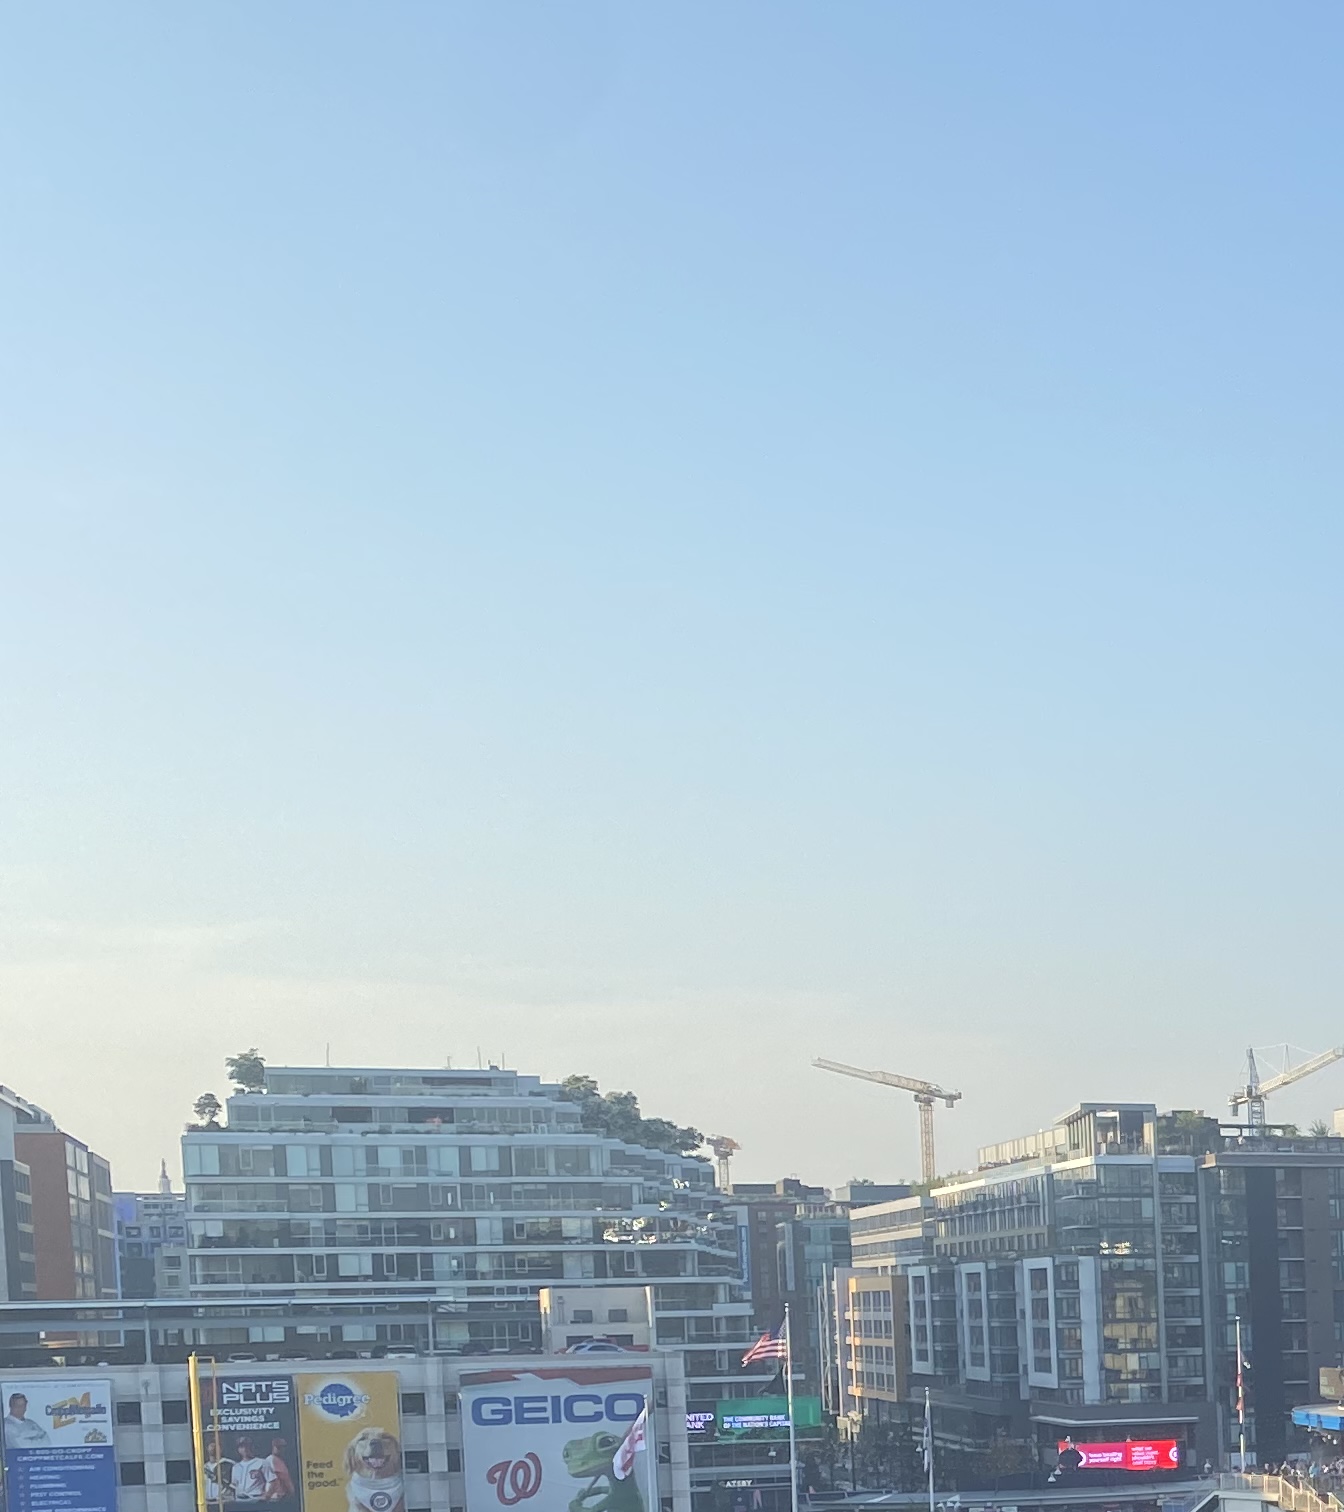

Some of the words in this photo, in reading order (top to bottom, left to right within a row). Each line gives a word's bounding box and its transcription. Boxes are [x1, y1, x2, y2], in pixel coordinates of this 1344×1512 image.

[222, 1380, 289, 1394] NATS
[223, 1393, 290, 1405] PLUS
[304, 1393, 370, 1406] Pedigree
[471, 1392, 646, 1427] GEICO
[686, 1412, 715, 1422] NITED
[686, 1421, 705, 1430] ANK
[306, 1460, 333, 1469] Feed
[308, 1470, 324, 1479] the
